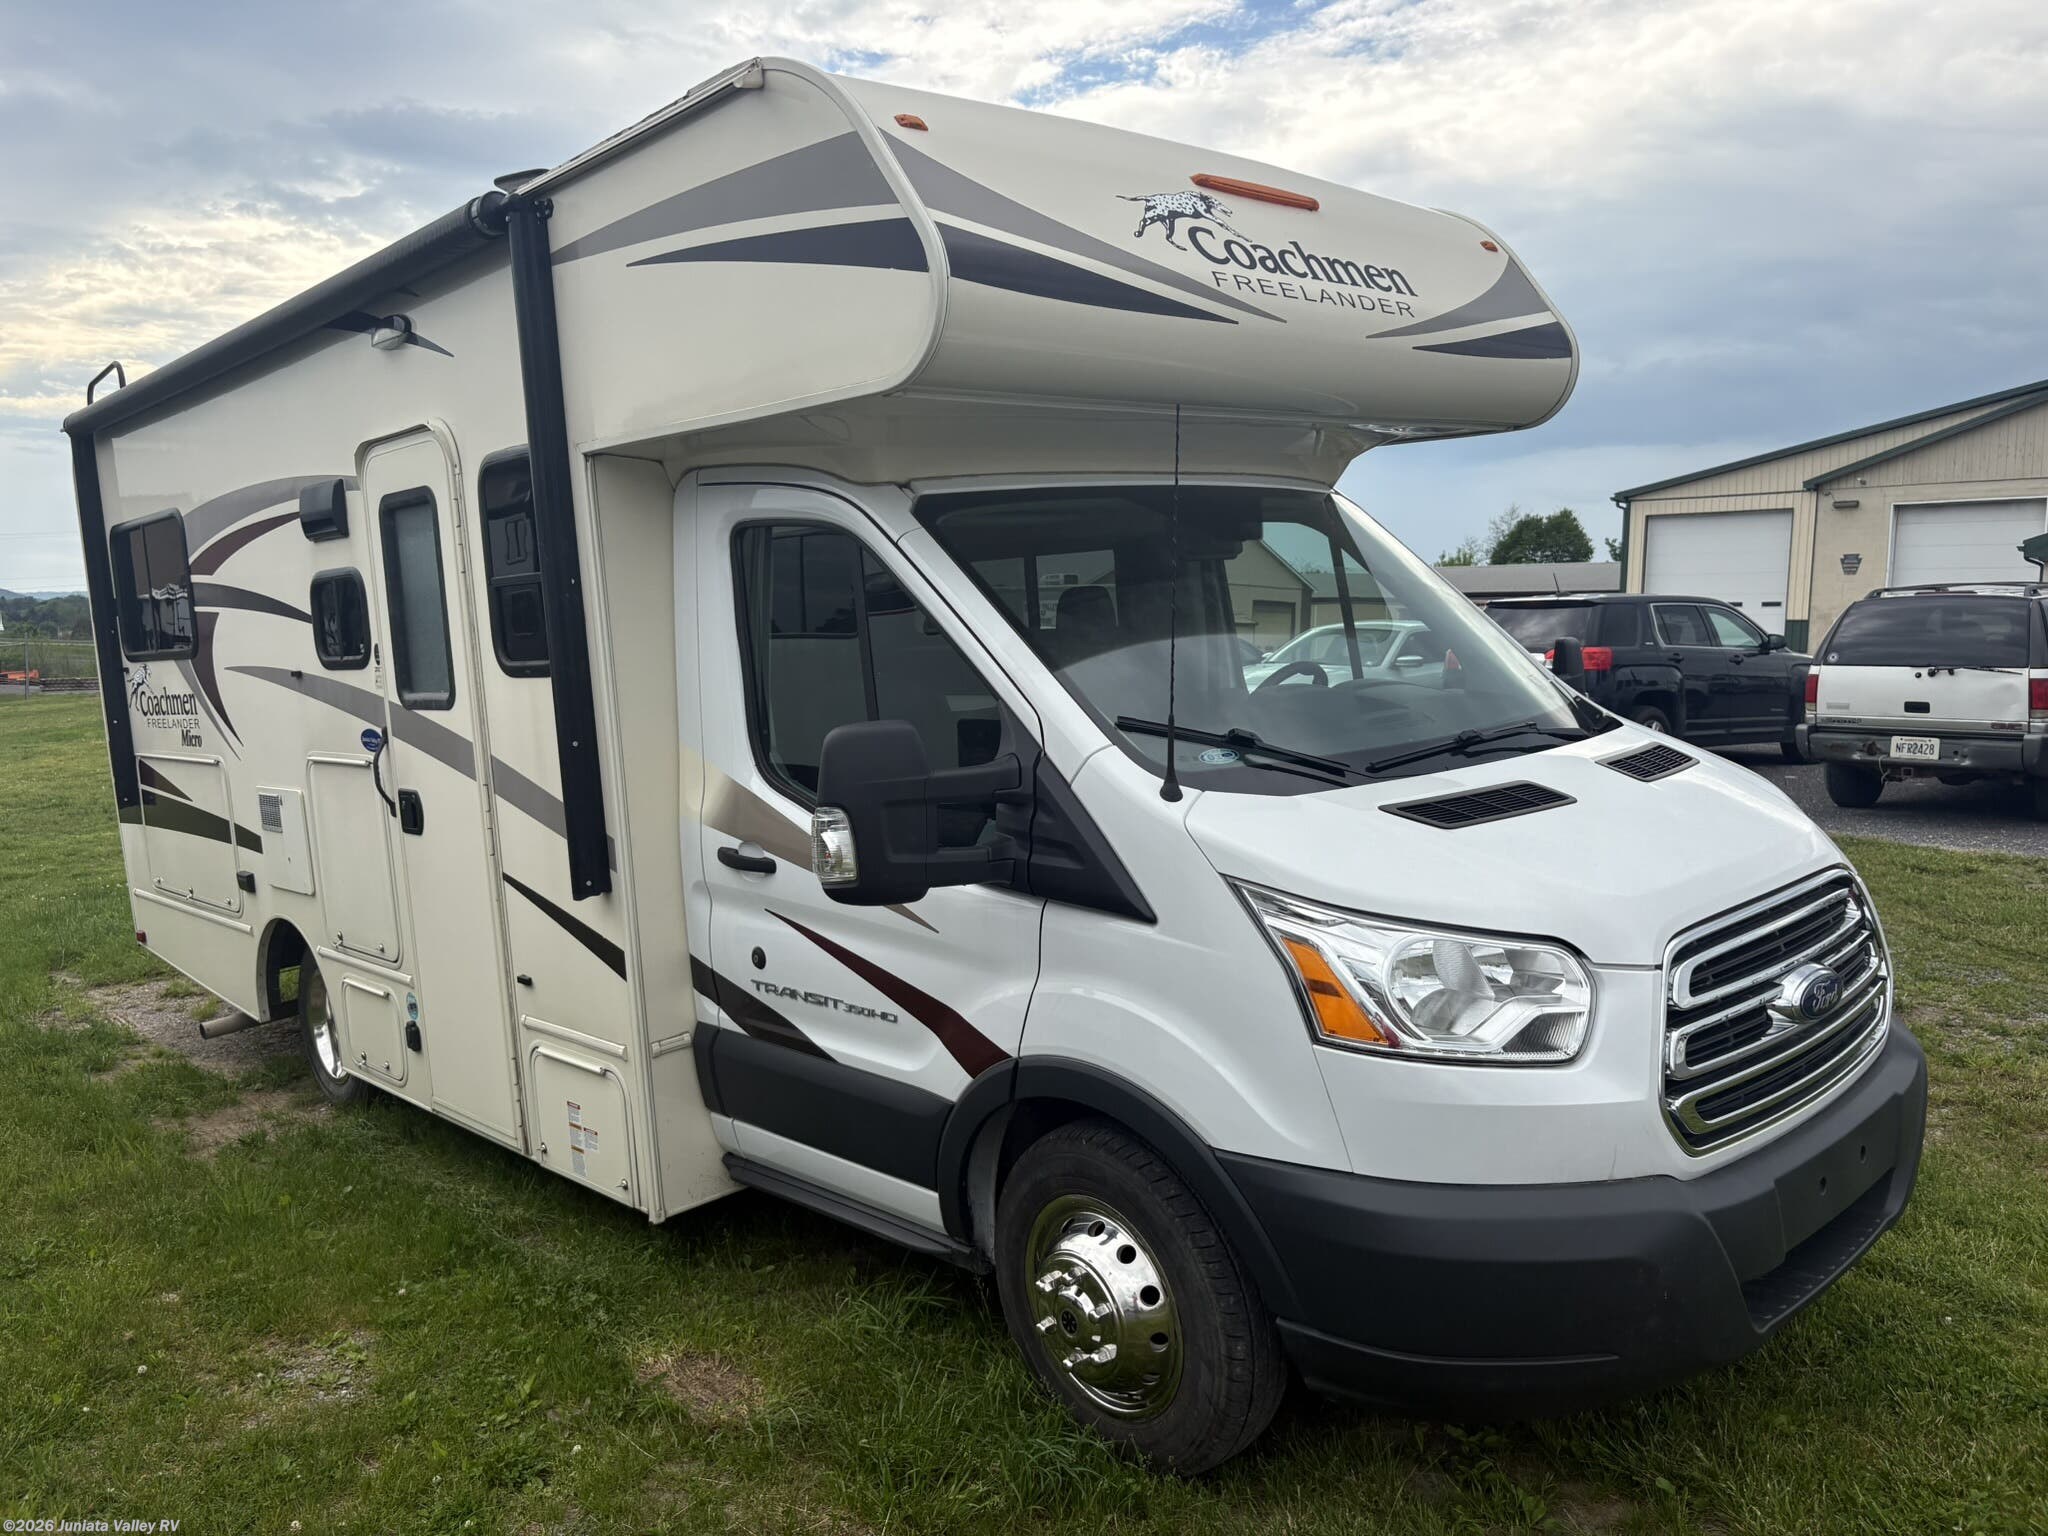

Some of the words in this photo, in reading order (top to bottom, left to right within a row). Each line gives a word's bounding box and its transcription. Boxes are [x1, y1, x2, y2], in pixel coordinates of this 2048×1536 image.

[1188, 226, 1418, 297] Coachmen
[1211, 271, 1415, 317] FREELANDER
[140, 686, 198, 717] Coachmen
[147, 718, 201, 729] FREELANDER
[181, 730, 203, 747] Micro
[751, 979, 844, 1011] TRANSIT
[1813, 980, 1839, 1012] Ford
